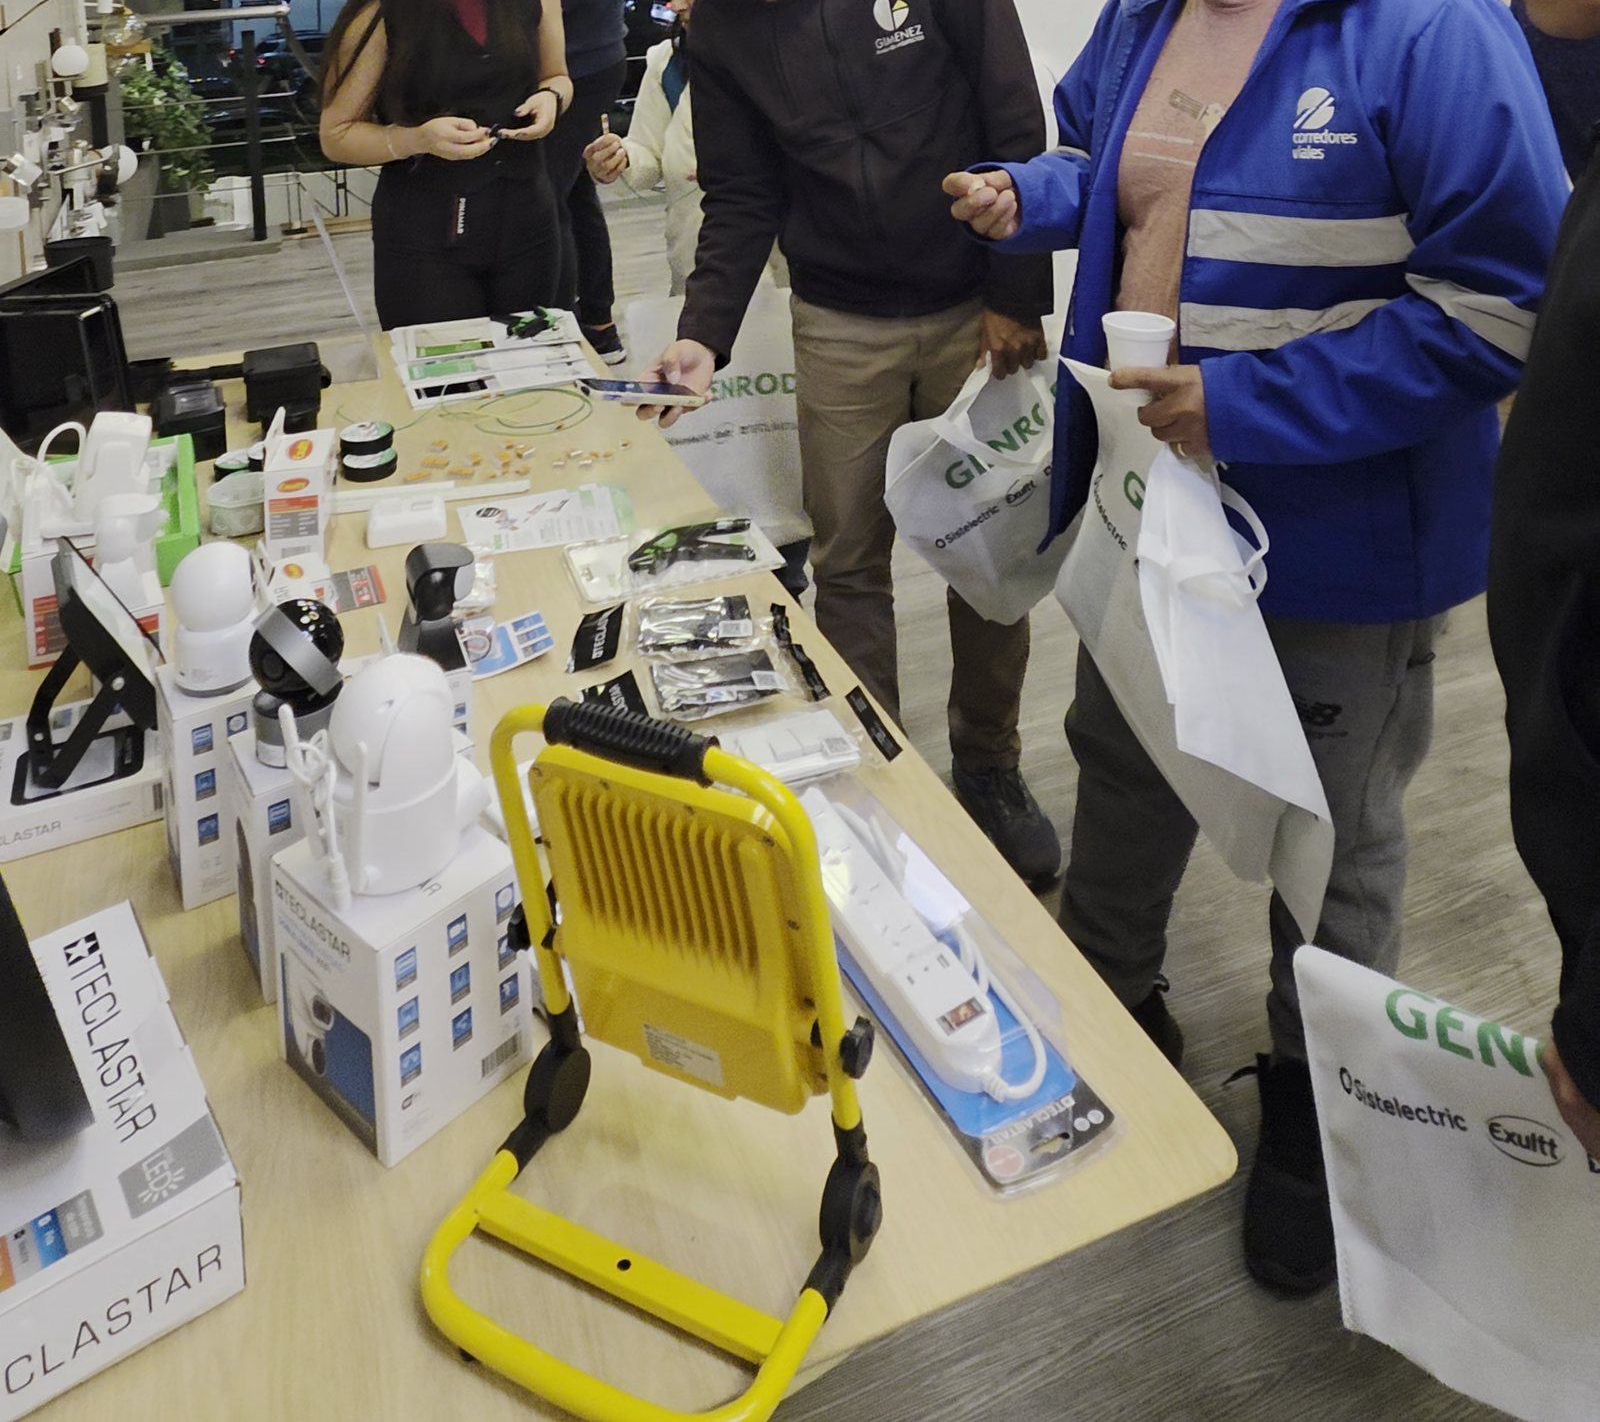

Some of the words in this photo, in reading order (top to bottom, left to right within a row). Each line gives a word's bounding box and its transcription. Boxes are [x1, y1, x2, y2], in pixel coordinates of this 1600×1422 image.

[875, 24, 923, 49] GIMENEZ
[1292, 128, 1358, 145] corredores
[1292, 145, 1326, 160] viales
[944, 505, 1001, 545] Sistelectric
[1006, 479, 1036, 505] Exultt
[70, 953, 157, 1144] TECLASTAR
[1354, 1078, 1468, 1132] Sistelectric
[1487, 1122, 1558, 1160] Exultt
[142, 1151, 172, 1191] LED
[5, 1244, 222, 1395] CLASTAR
